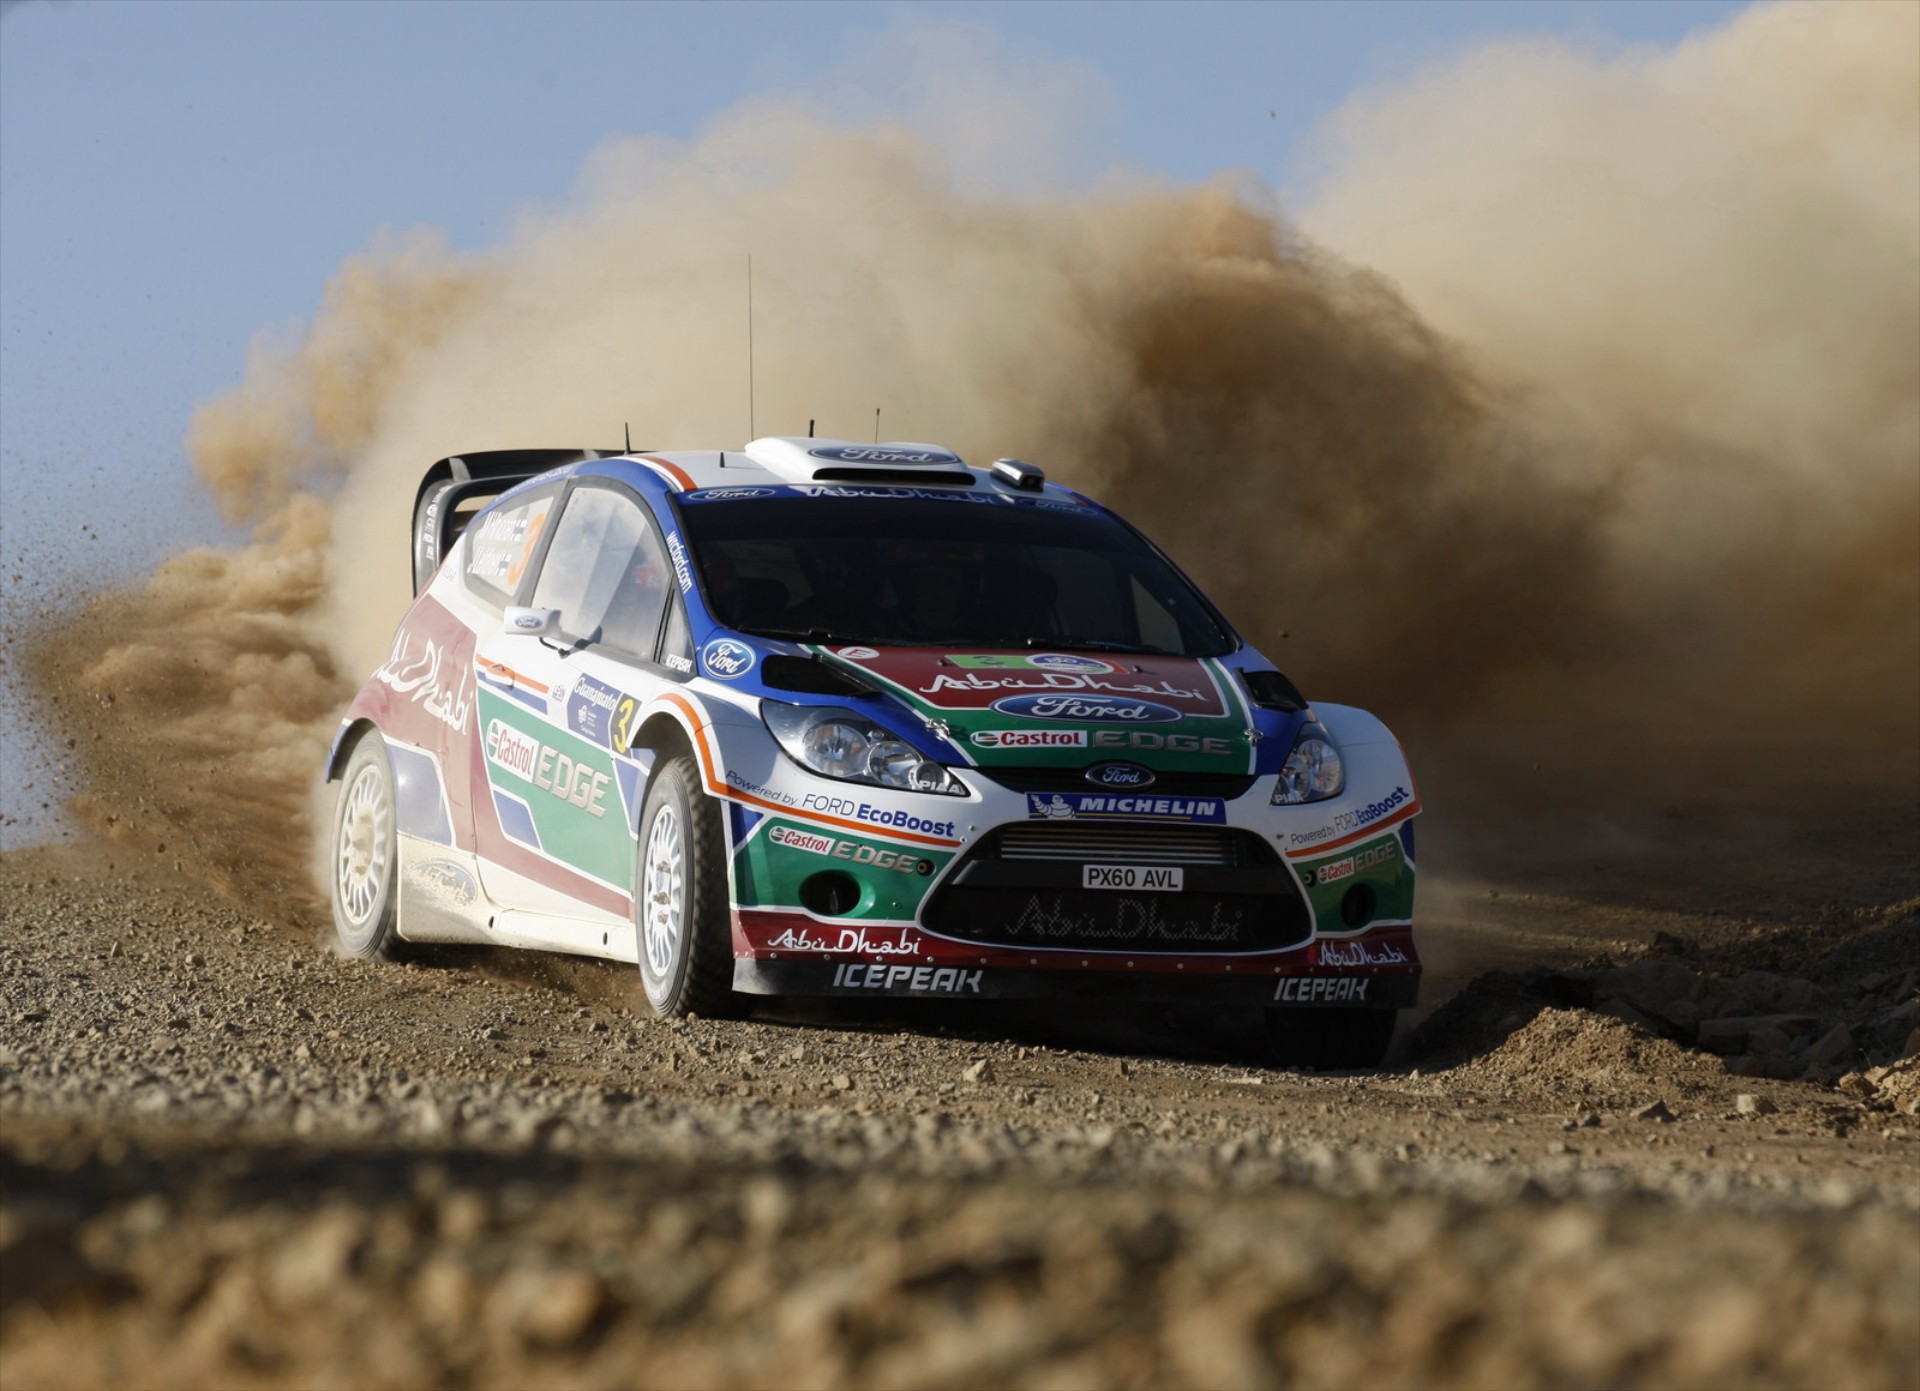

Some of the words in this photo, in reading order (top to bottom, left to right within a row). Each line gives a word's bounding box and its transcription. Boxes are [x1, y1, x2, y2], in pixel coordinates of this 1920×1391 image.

[838, 446, 934, 464] Ford
[705, 489, 760, 499] Ford
[506, 512, 545, 585] 3
[666, 531, 693, 594] wrcford.com
[708, 646, 744, 674] Ford
[574, 677, 617, 710] Guanajuato
[1031, 696, 1151, 721] Ford
[614, 699, 634, 753] 3
[1000, 731, 1082, 746] Castrol
[1094, 731, 1233, 755] EDGE
[497, 724, 533, 776] Castrol
[537, 745, 612, 819] EDGE
[1102, 768, 1140, 785] Ford
[919, 780, 960, 793] PIAA
[726, 770, 781, 800] Powered
[782, 792, 798, 806] by
[802, 793, 855, 816] FORD
[856, 804, 955, 837] EcoBoost
[1079, 798, 1217, 817] MICHELIN
[1290, 826, 1328, 845] Powered
[1327, 824, 1335, 838] by
[1334, 811, 1357, 832] FORD
[1357, 786, 1410, 825] EcoBoost
[784, 829, 831, 852] Castrol
[832, 841, 918, 874] EDGE
[1327, 863, 1353, 880] Castrol
[1355, 841, 1396, 870] EDGE
[1088, 869, 1136, 887] PX60
[1142, 871, 1178, 888] AVL
[768, 928, 835, 950] Abu
[838, 929, 922, 954] Dhabi
[832, 963, 983, 993] ICEPEAK
[1274, 977, 1370, 1000] ICEPEAK
